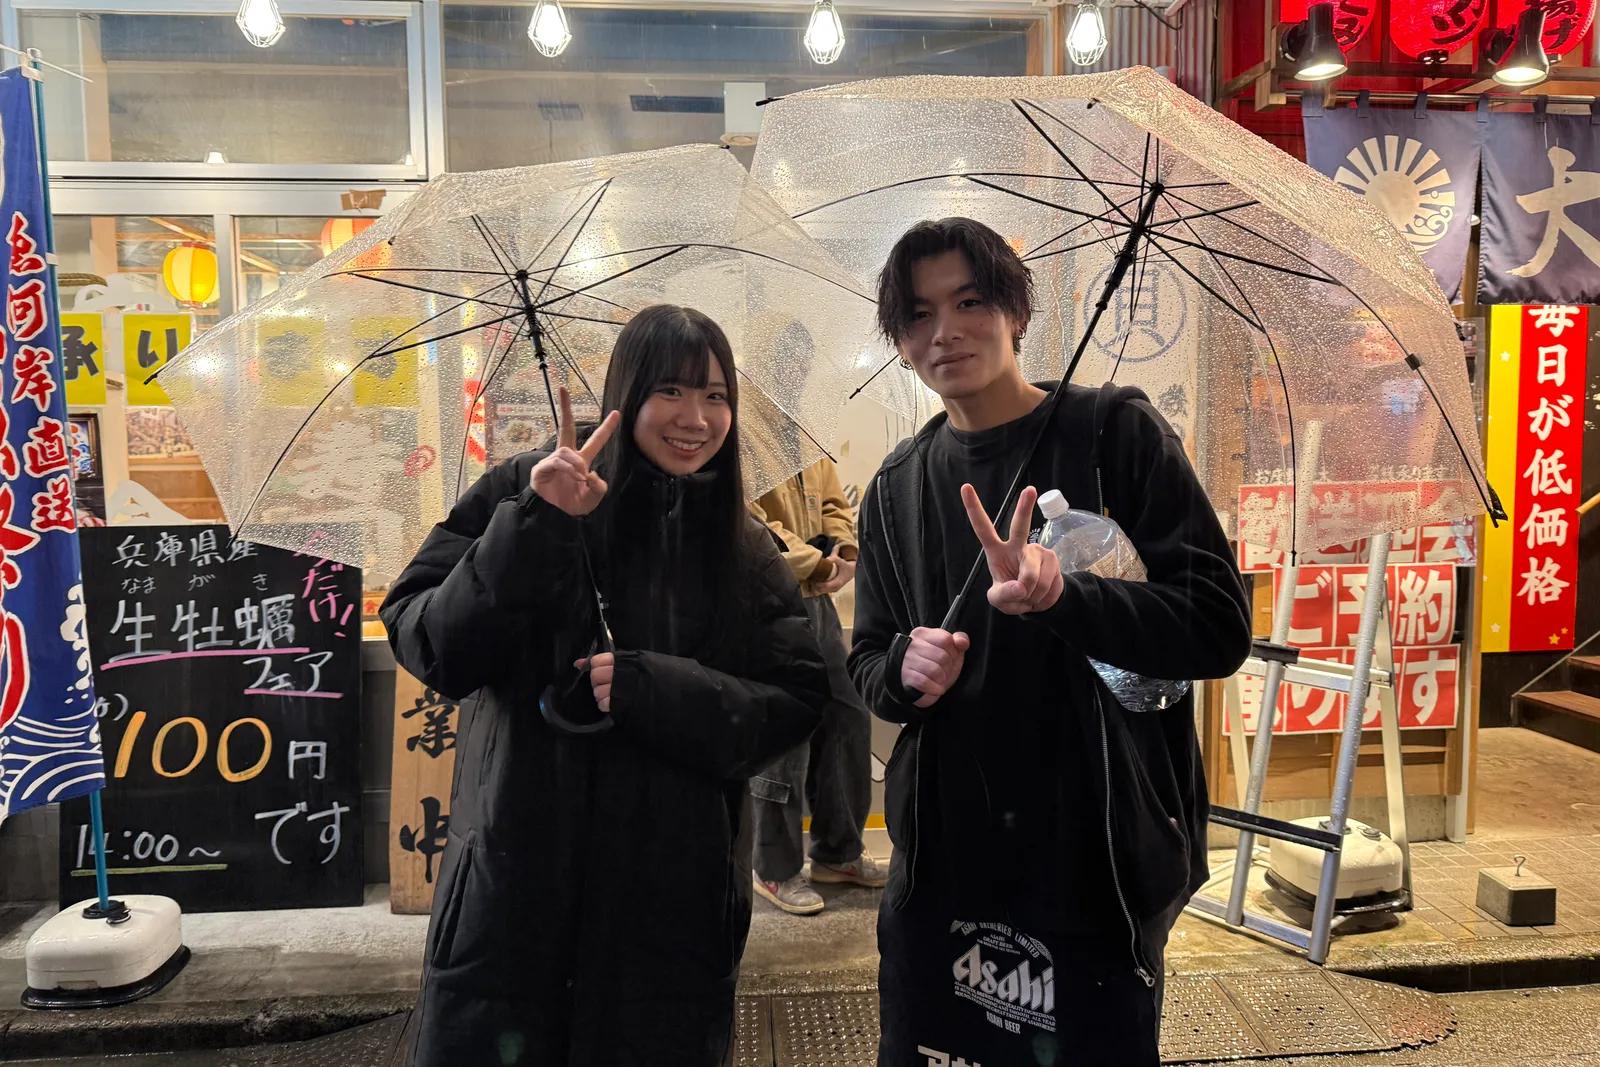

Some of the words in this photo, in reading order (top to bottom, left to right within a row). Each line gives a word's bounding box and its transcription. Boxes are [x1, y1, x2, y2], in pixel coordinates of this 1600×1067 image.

[1516, 304, 1579, 606] 毎日が低価格
[112, 529, 258, 568] 兵庫県産
[121, 577, 156, 594] なま
[188, 574, 216, 591] が
[252, 573, 269, 591] き
[1286, 569, 1453, 645] ご予約
[109, 594, 296, 663] 生牡蠣
[242, 651, 334, 693] フェア
[1228, 651, 1457, 727] りす
[254, 801, 350, 865] です
[1014, 932, 1040, 958] LIMITED
[952, 943, 1055, 1014] Asahi
[1004, 1019, 1021, 1034] BEER
[917, 1045, 982, 1067] ア
